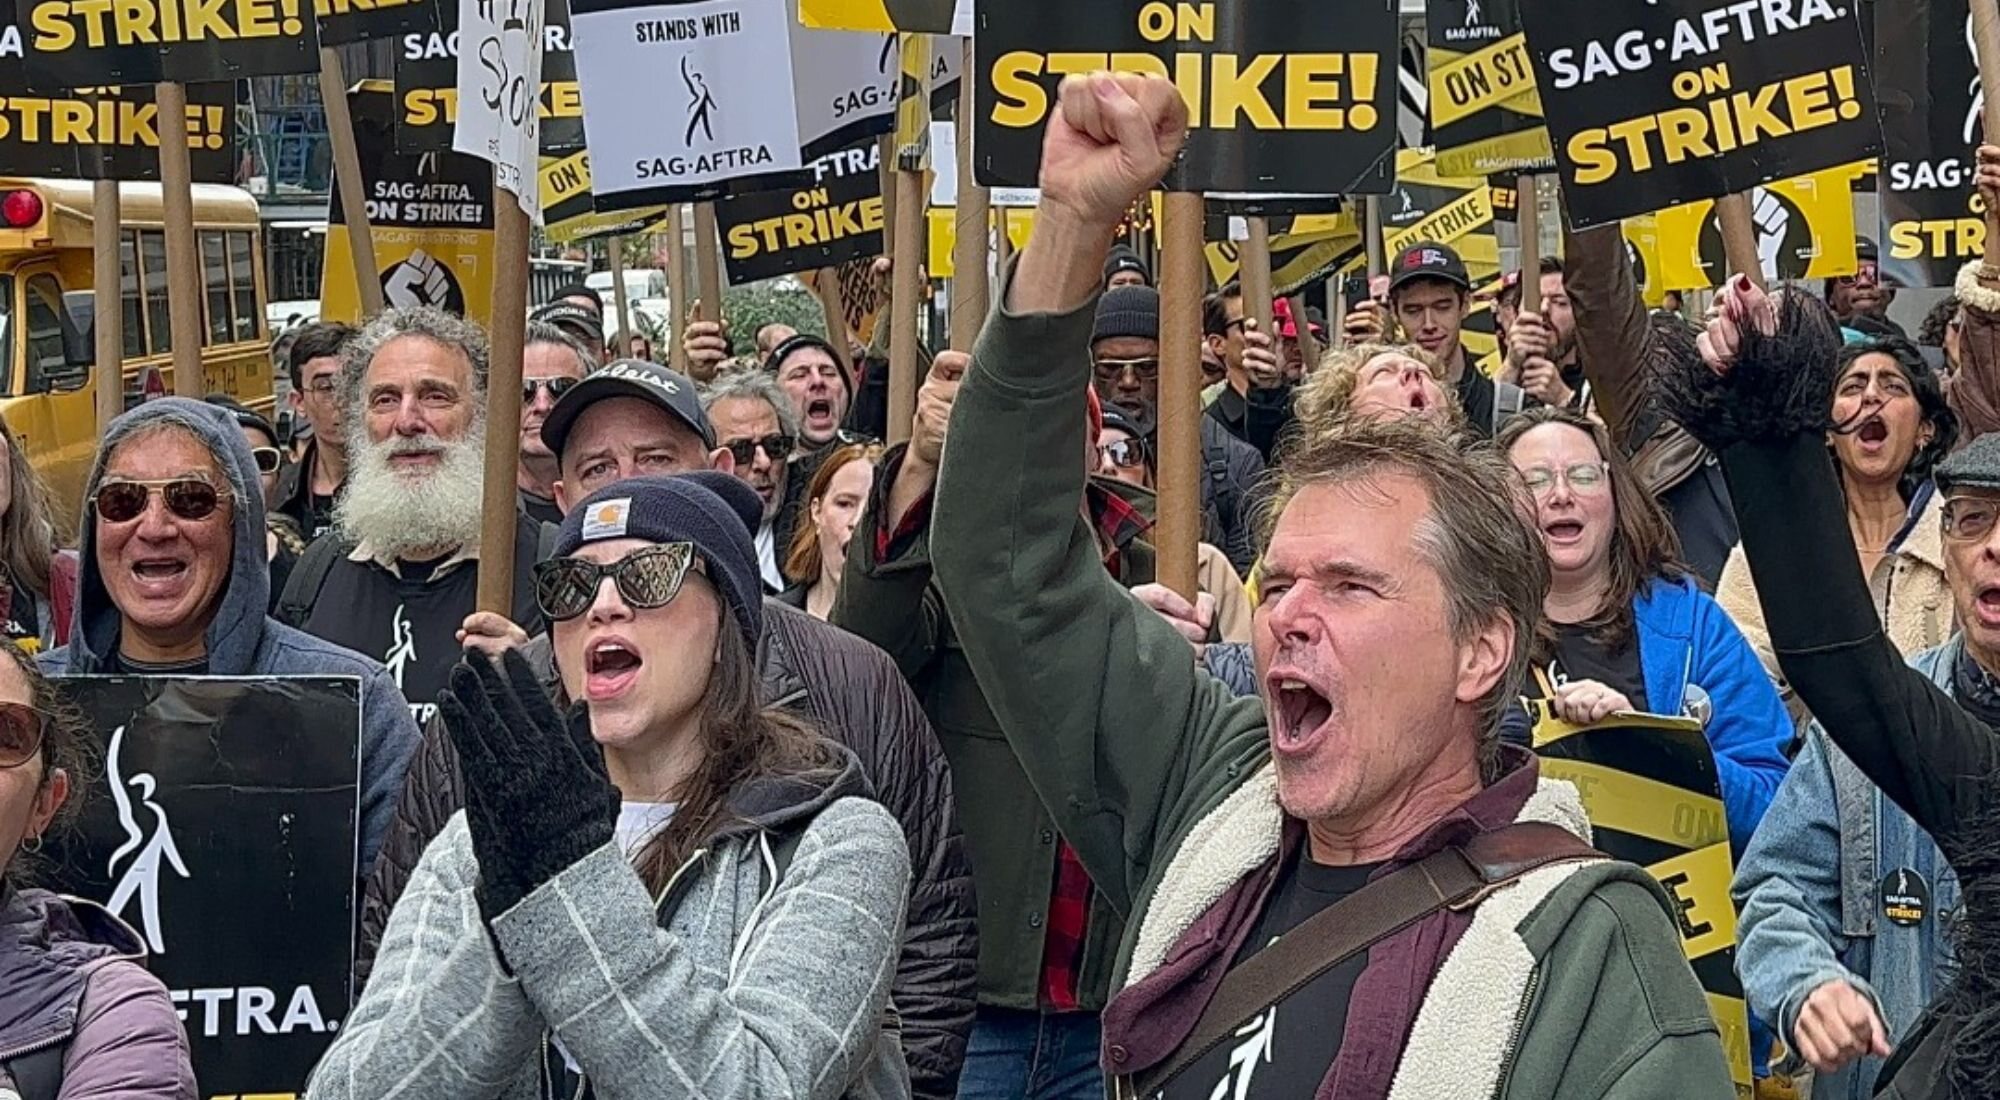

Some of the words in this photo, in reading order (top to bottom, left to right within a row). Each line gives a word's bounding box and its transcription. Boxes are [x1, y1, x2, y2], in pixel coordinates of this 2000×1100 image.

[31, 0, 303, 51] STRIKE!
[636, 18, 697, 43] STANDS
[702, 12, 740, 37] WITH
[1138, 2, 1214, 42] ON
[1445, 61, 1491, 106] ON
[1672, 63, 1731, 100] ON
[0, 97, 224, 149] TRIKE!
[1567, 65, 1861, 184] STRIKE!
[549, 163, 581, 194] ON
[636, 144, 773, 179] SAG·AFTRA
[365, 199, 398, 220] ON
[404, 201, 483, 223] STRIKE!
[792, 187, 829, 209] ON
[1420, 197, 1485, 242] STRIKE
